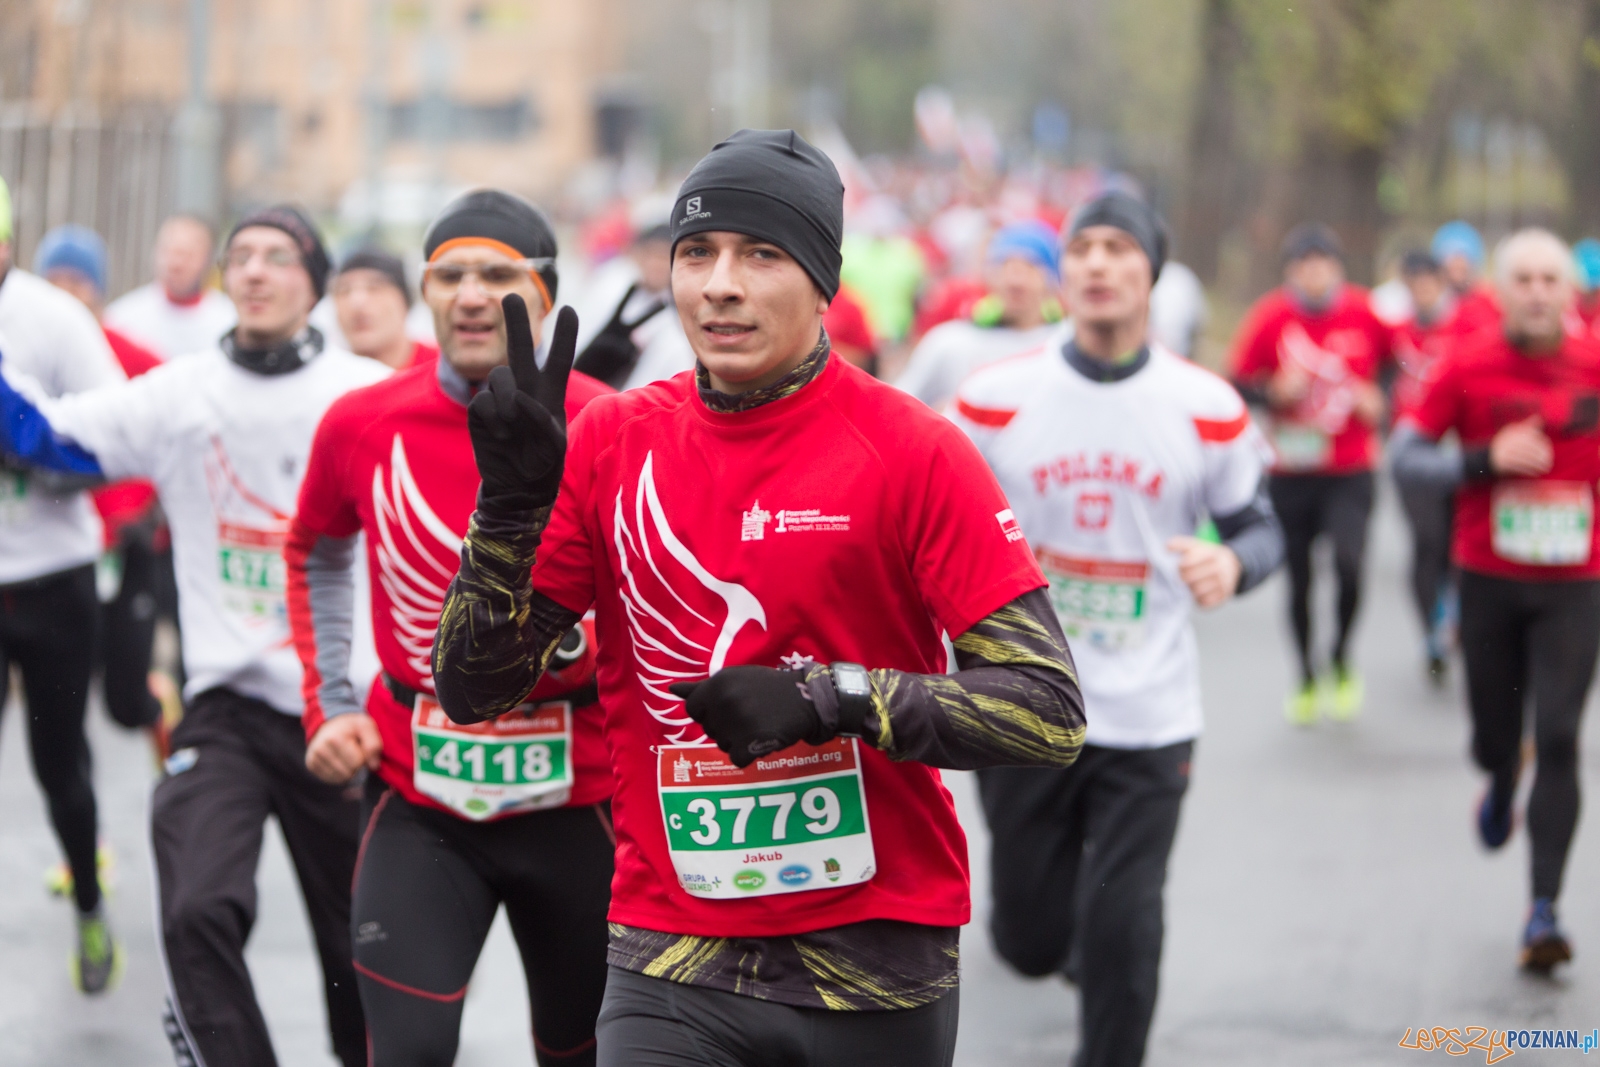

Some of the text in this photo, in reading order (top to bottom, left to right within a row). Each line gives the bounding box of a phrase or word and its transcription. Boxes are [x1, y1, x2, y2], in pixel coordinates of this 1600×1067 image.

[1032, 453, 1165, 500] POLSKA
[775, 510, 787, 532] 1
[433, 741, 553, 783] 4118
[756, 751, 843, 771] RunPoland.org
[669, 786, 842, 846] C 3779
[742, 851, 783, 864] Jakub
[682, 873, 707, 883] GRUPA
